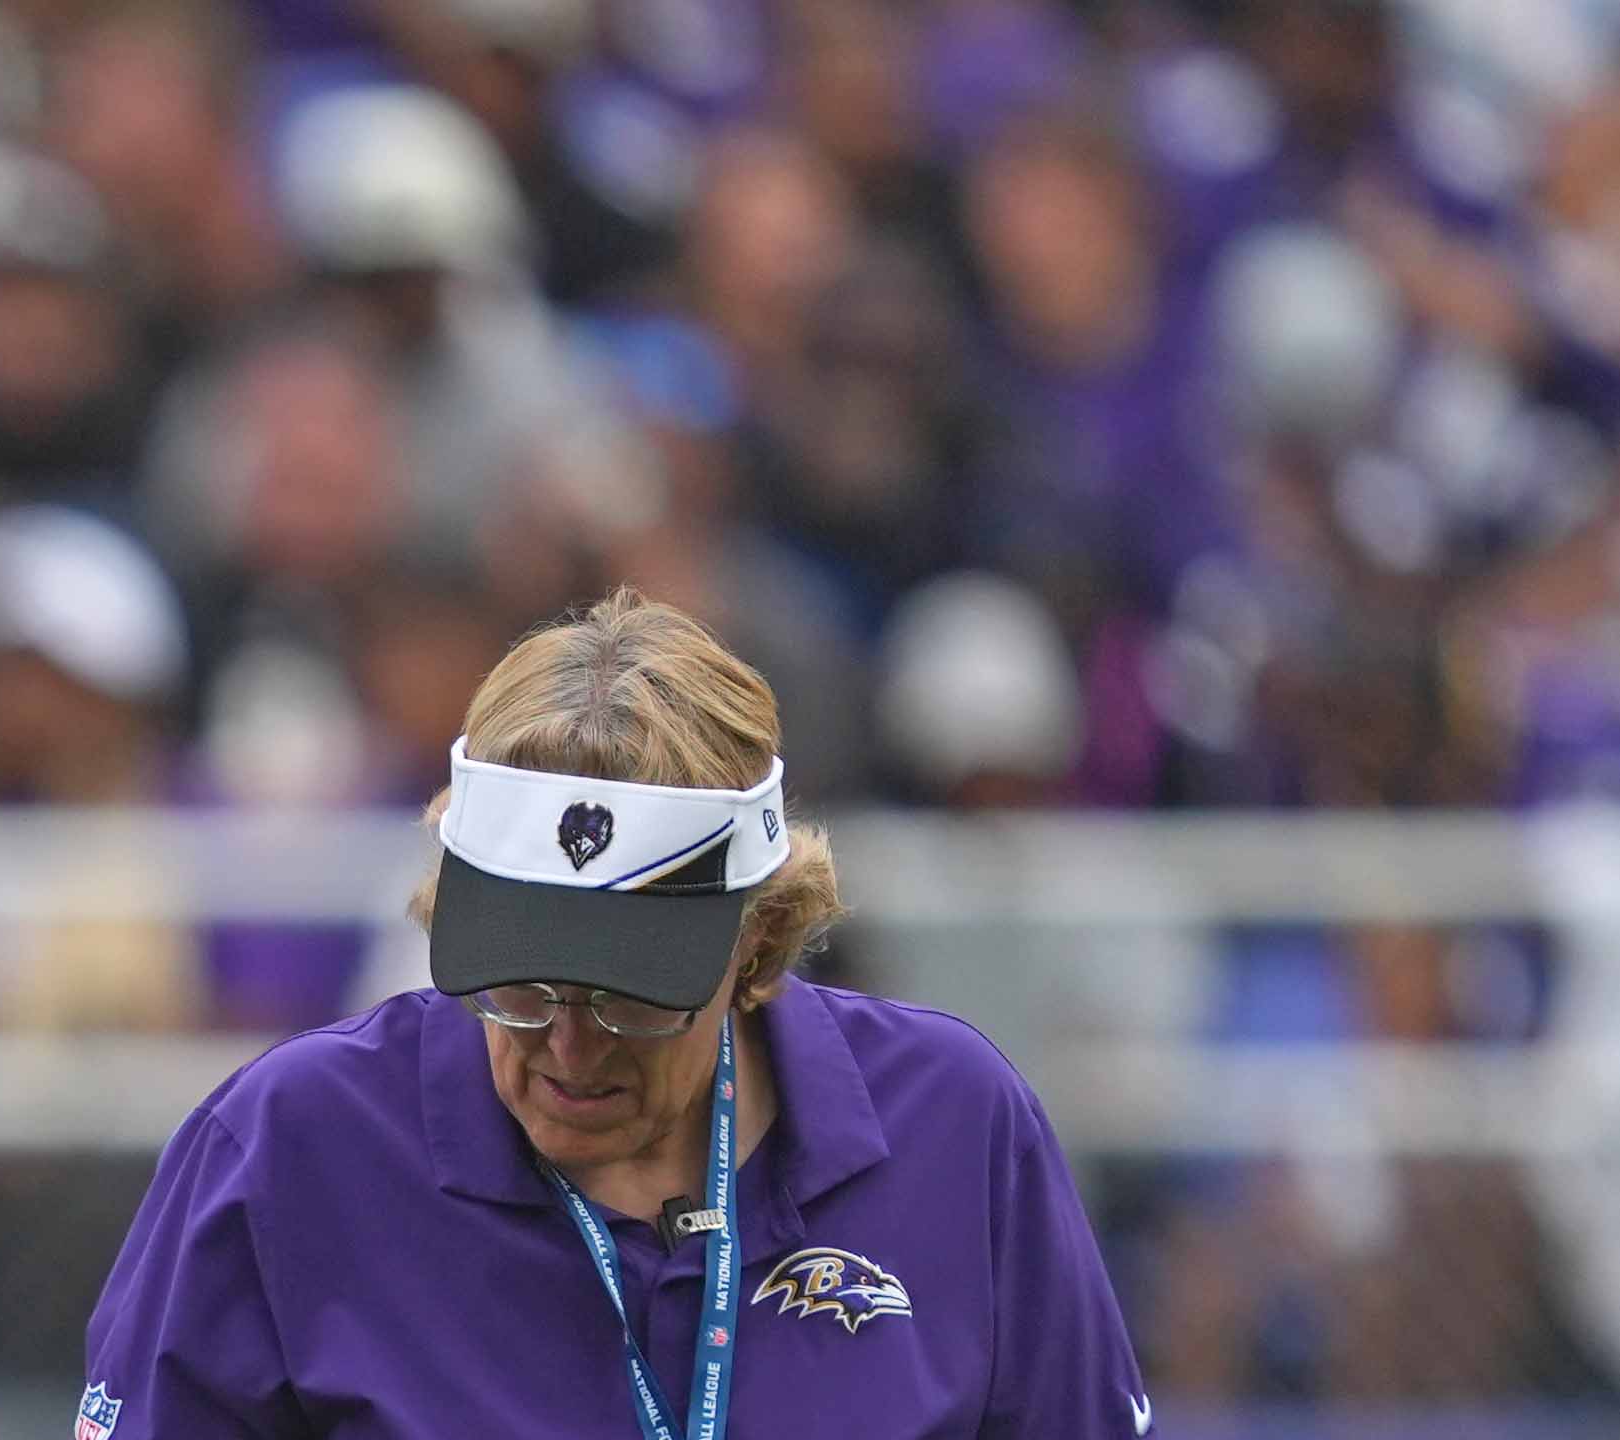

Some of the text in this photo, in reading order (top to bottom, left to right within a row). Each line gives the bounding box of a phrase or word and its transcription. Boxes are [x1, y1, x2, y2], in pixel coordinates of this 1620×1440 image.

[717, 1114, 730, 1169] LEAGUE
[714, 1241, 732, 1311] NATIONAL
[631, 1359, 662, 1426] NATIONAL
[702, 1361, 721, 1419] LEAGUE
